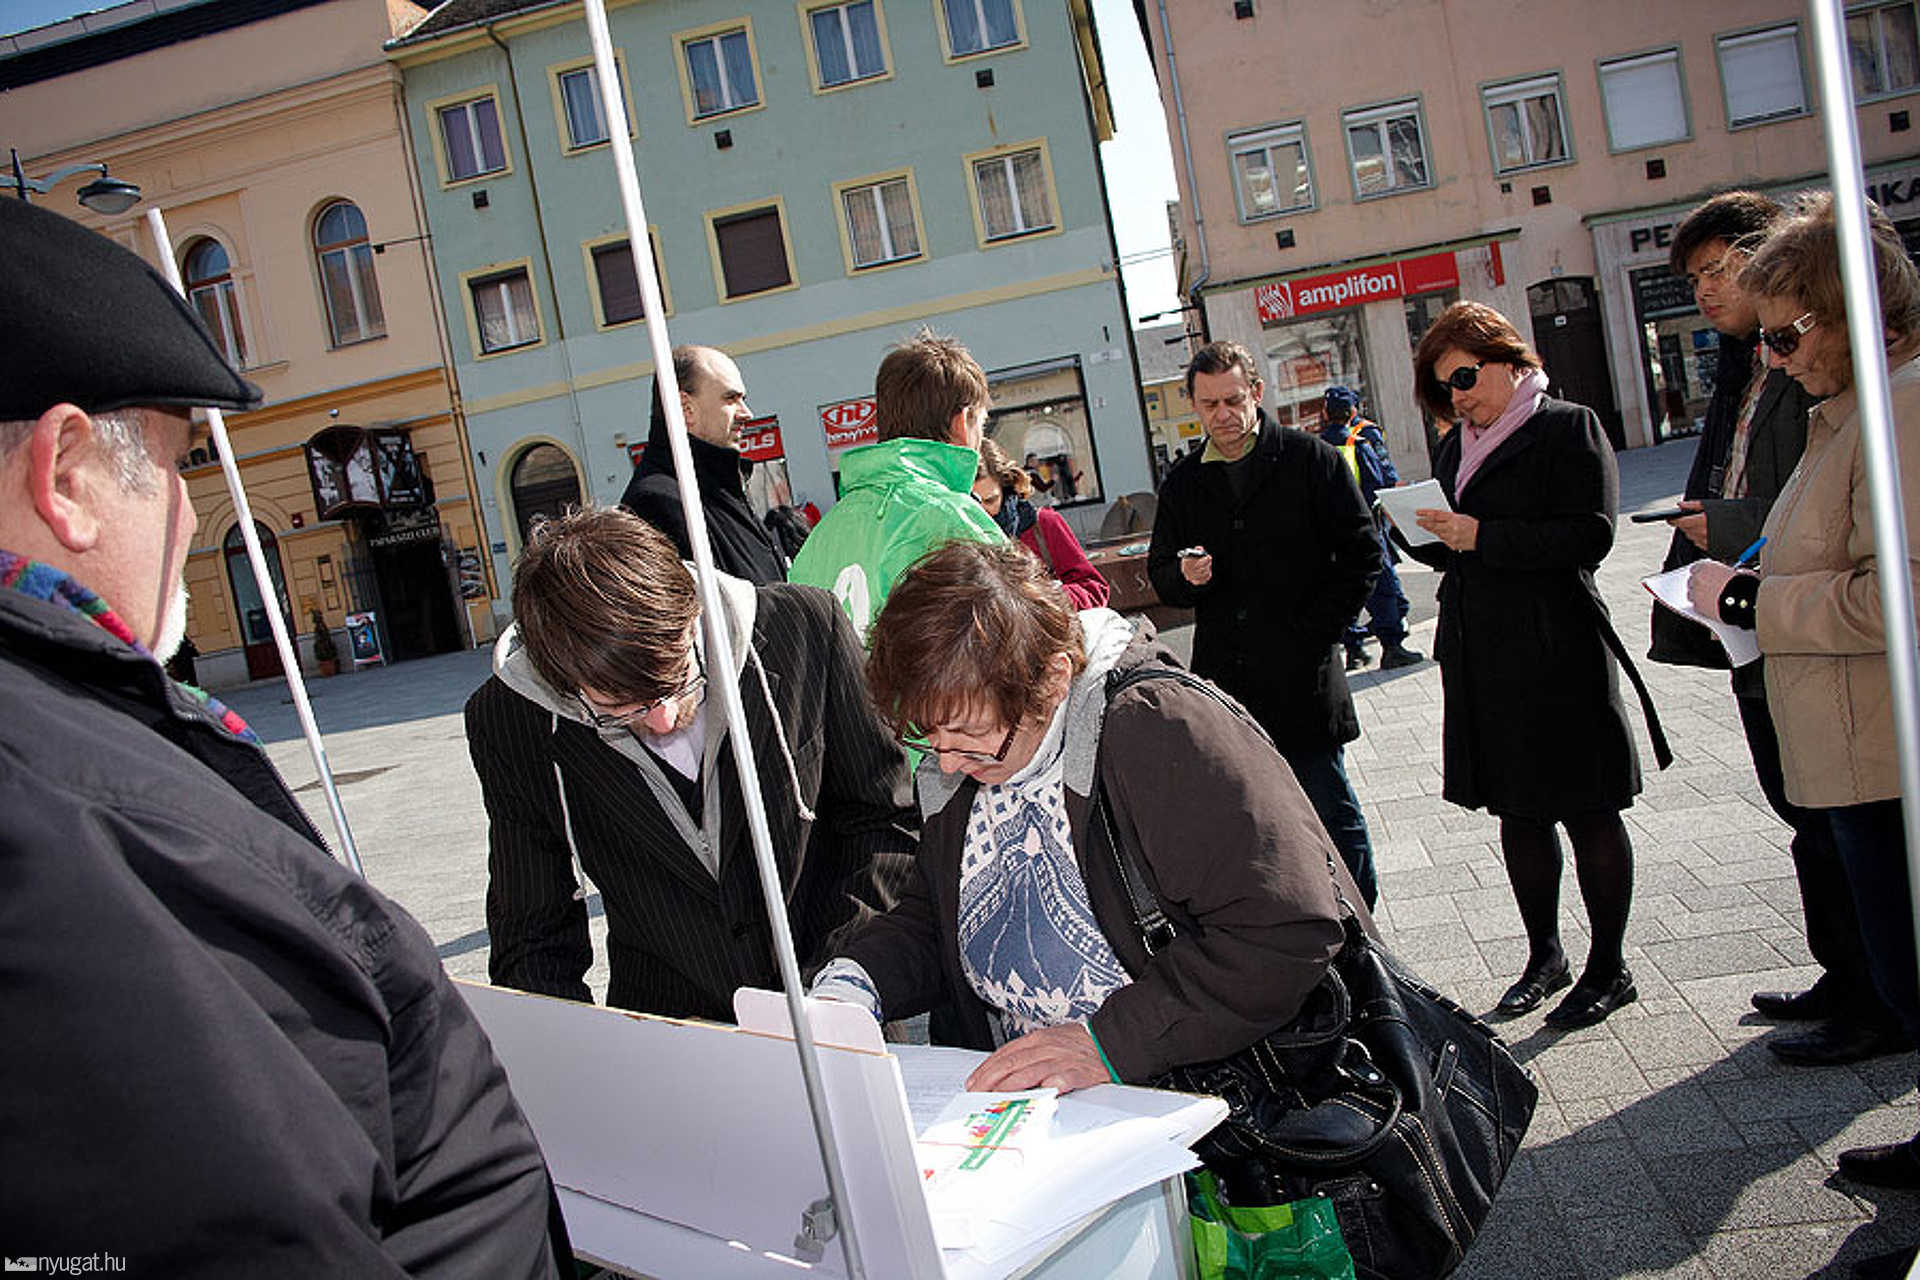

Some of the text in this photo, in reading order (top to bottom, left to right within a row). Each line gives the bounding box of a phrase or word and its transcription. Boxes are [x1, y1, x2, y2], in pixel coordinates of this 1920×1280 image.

[1629, 223, 1674, 253] PE
[1299, 272, 1397, 306] amplifon
[738, 432, 776, 452] OLS
